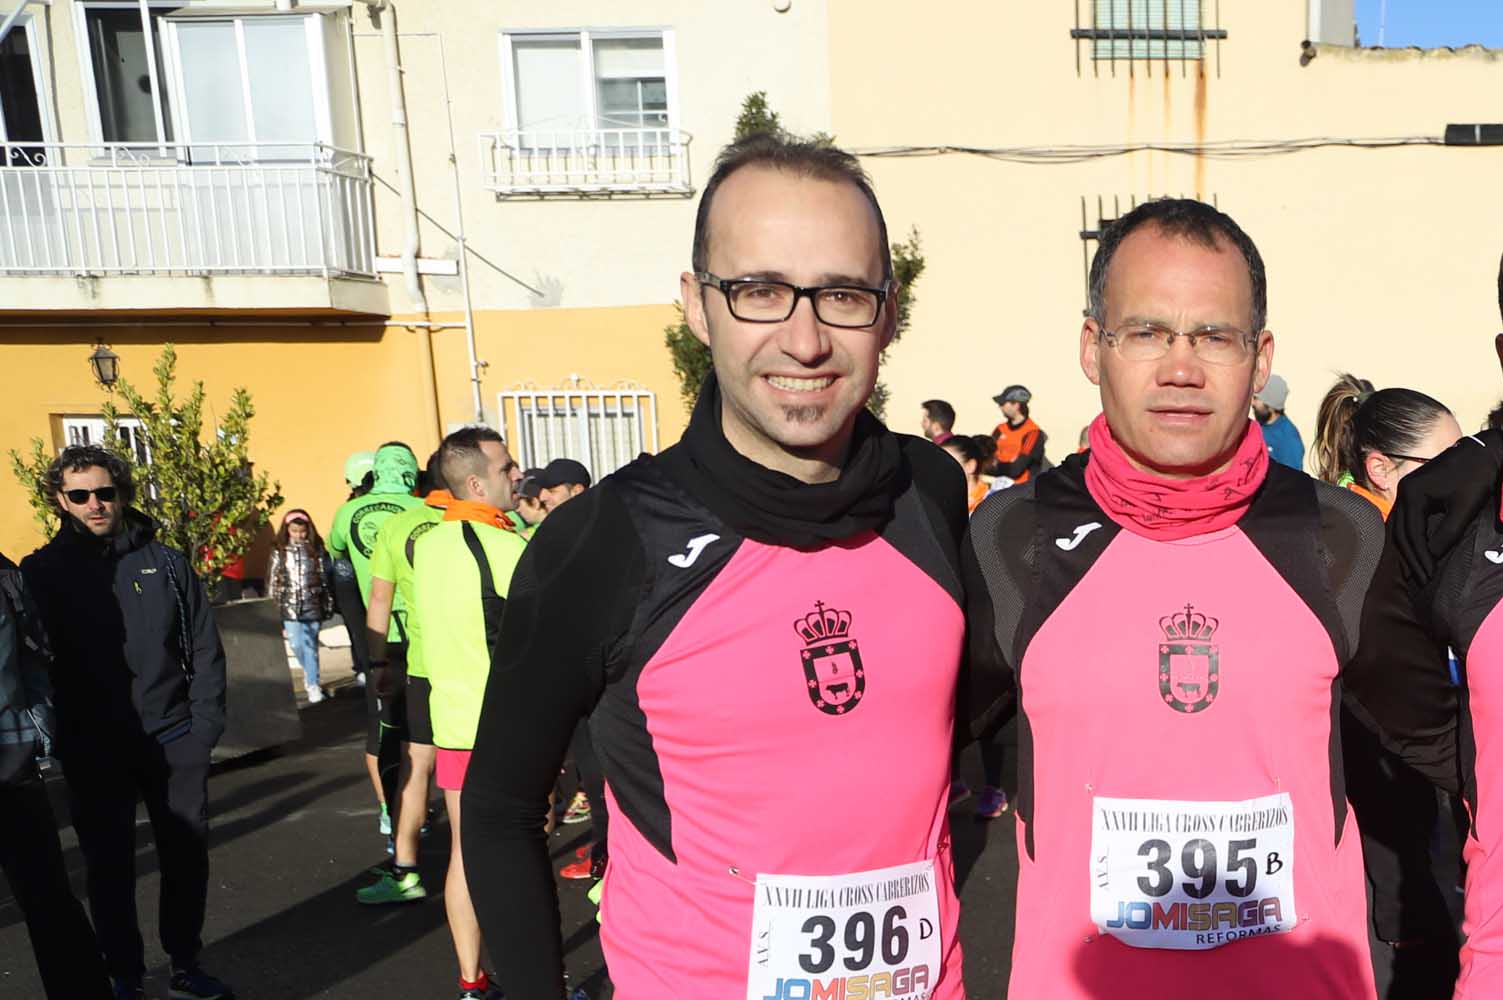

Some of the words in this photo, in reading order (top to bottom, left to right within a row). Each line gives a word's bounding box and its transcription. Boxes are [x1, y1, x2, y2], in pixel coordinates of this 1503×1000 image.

[1142, 811, 1171, 832] LIGA
[1175, 813, 1216, 833] CROSS
[1219, 807, 1289, 832] CABRERIZOS
[1136, 838, 1258, 899] 395
[1265, 852, 1283, 875] B
[805, 887, 836, 909] LIGA
[839, 885, 874, 907] CROSS
[876, 873, 930, 902] CABRERIZOS
[920, 918, 933, 940] D
[1106, 897, 1283, 931] JOMISAGA
[798, 905, 910, 974] 396
[1196, 925, 1281, 945] REFORMAS
